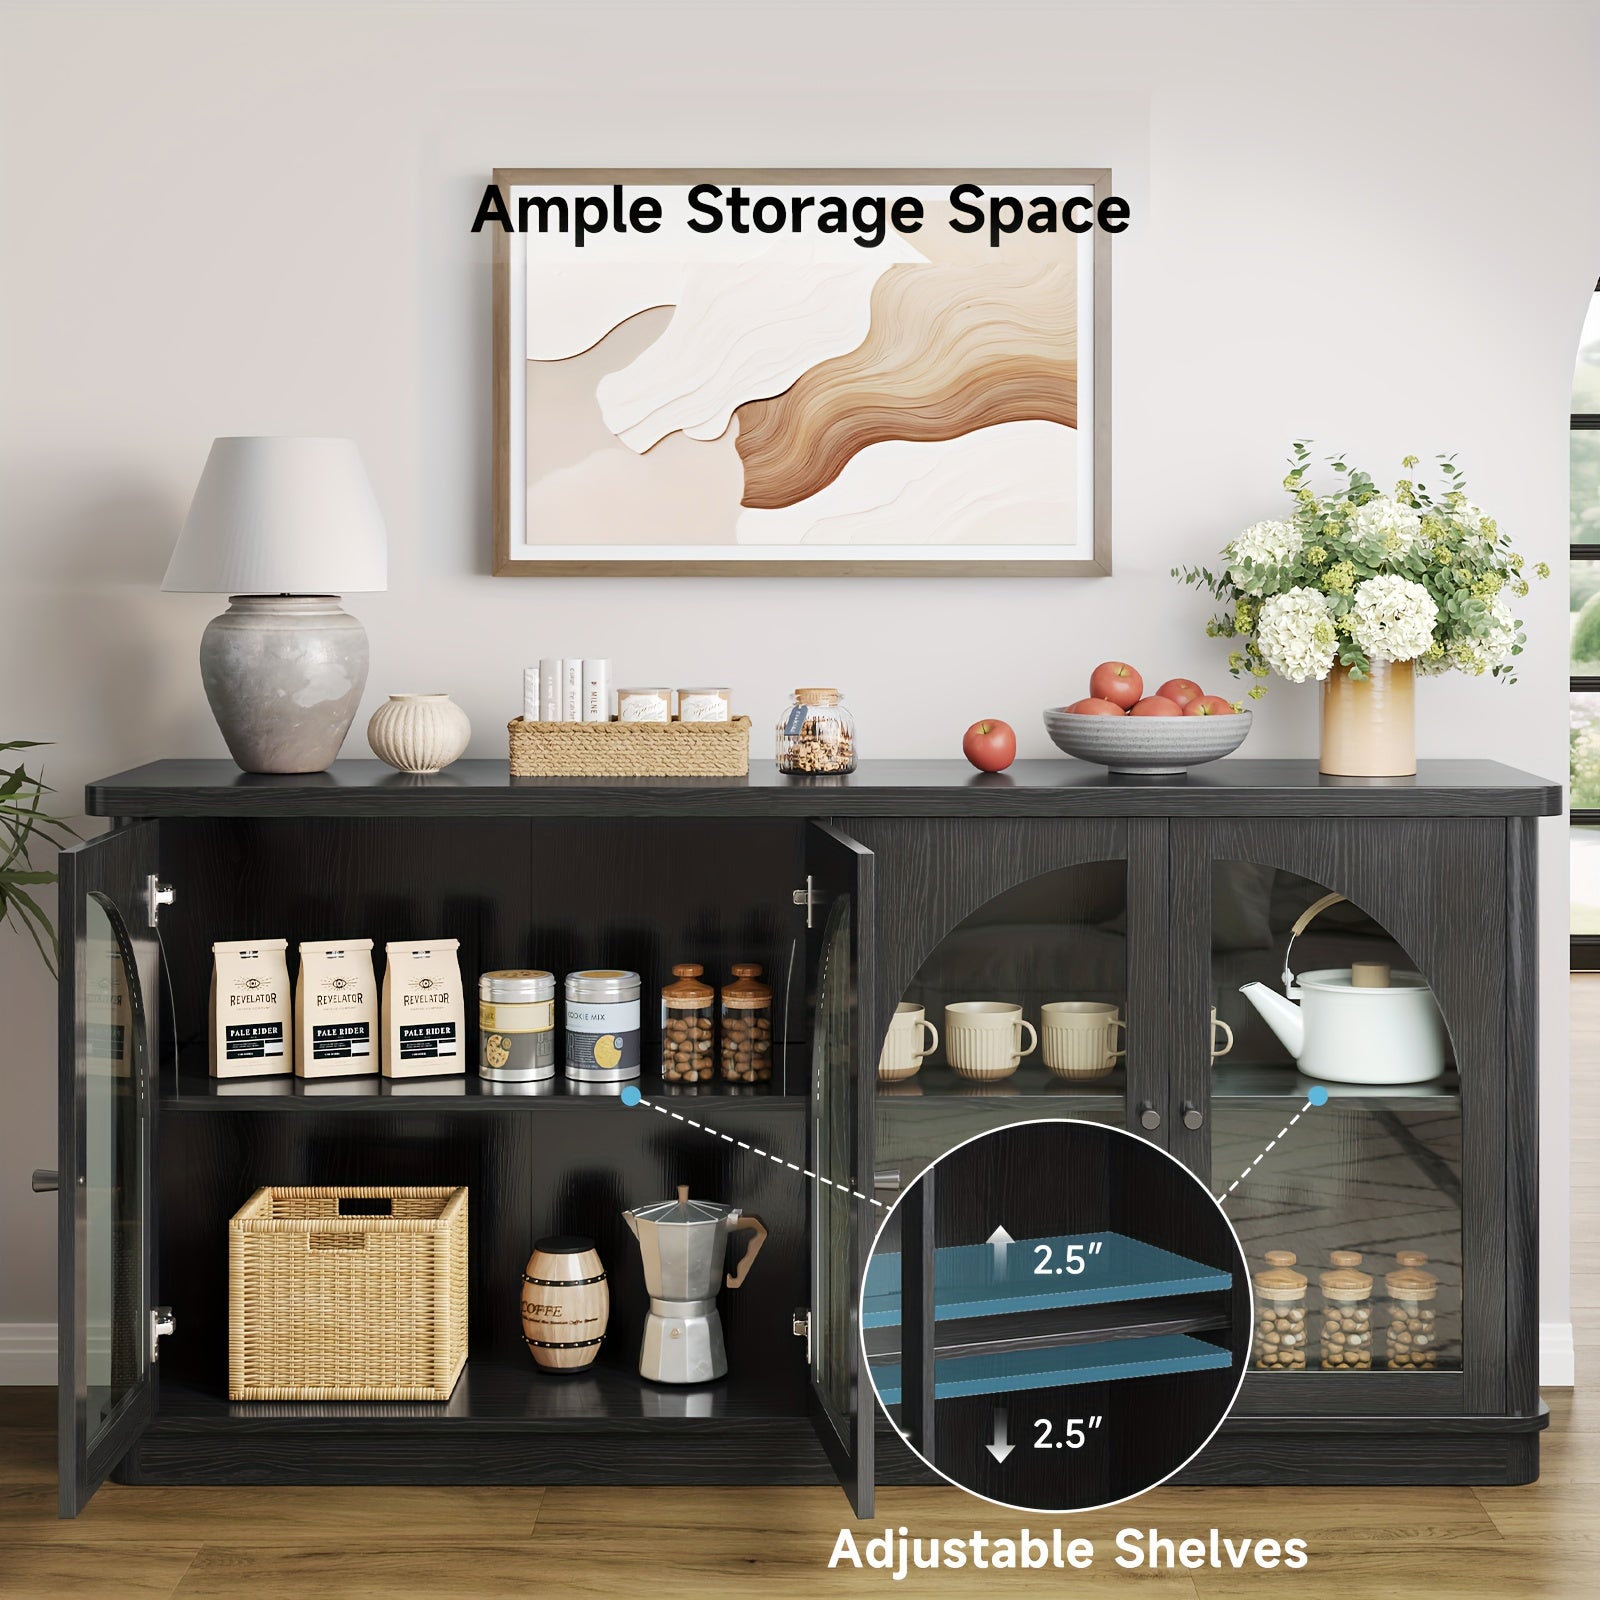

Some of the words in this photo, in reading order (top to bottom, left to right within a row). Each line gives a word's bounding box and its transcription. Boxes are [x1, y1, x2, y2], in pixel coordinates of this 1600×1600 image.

[590, 691, 598, 714] MILNE
[230, 992, 277, 1006] REVELATOR
[317, 992, 363, 1006] REVELATOR
[403, 992, 450, 1006] REVELATOR
[230, 1029, 251, 1037] PALE
[252, 1026, 278, 1035] RIDER
[317, 1029, 337, 1037] PALE
[339, 1026, 364, 1035] RIDER
[404, 1029, 424, 1037] PALE
[425, 1026, 451, 1035] RIDER
